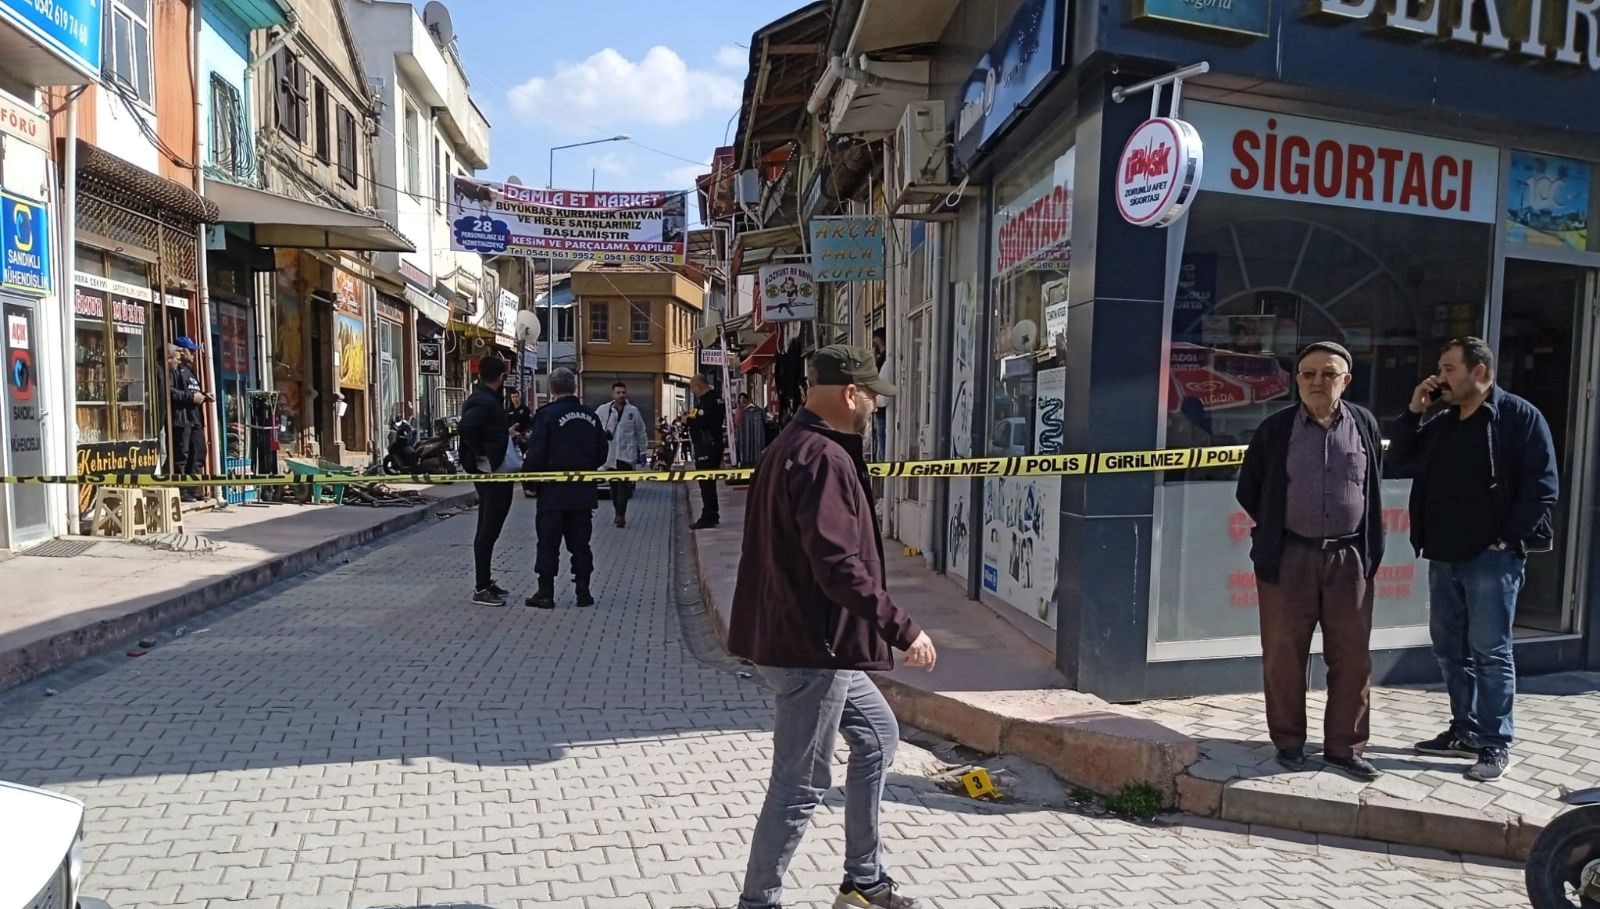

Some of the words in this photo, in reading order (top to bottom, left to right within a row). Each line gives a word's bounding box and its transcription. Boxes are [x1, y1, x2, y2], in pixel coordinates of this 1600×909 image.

[54, 5, 68, 31] 619
[69, 14, 78, 40] 74
[1, 107, 36, 137] FÖRÜ
[1230, 118, 1472, 212] SİGORTACI
[506, 187, 563, 206] DAMLA
[570, 193, 589, 207] ET
[594, 194, 660, 208] MARKET
[1124, 184, 1152, 198] ZORUNLU
[1151, 181, 1168, 191] AFET
[1129, 193, 1160, 206] SİGORTASI
[496, 201, 553, 217] BÜYÜKBAŞ
[557, 209, 615, 220] KURBANLIK
[619, 210, 662, 220] HAYVAN
[472, 220, 492, 232] 28
[518, 215, 531, 224] VE
[568, 218, 641, 232] SATIŞLARIMIZ
[816, 223, 877, 240] AKÇA
[543, 228, 629, 240] BAŞLAMIŞTIR
[548, 239, 562, 248] VE
[565, 241, 630, 252] PARÇALAMA
[8, 249, 41, 269] SANDIKLI
[553, 250, 568, 258] 561
[572, 251, 595, 260] 9952
[604, 254, 626, 262] 0541
[821, 247, 872, 262] PAÇA
[112, 299, 145, 324] MÜZİK
[12, 322, 26, 344] AÇIK
[558, 411, 596, 427] JANDARMA
[77, 448, 128, 475] Kehribar
[1207, 449, 1247, 464] POLİ
[972, 775, 983, 790] 3
